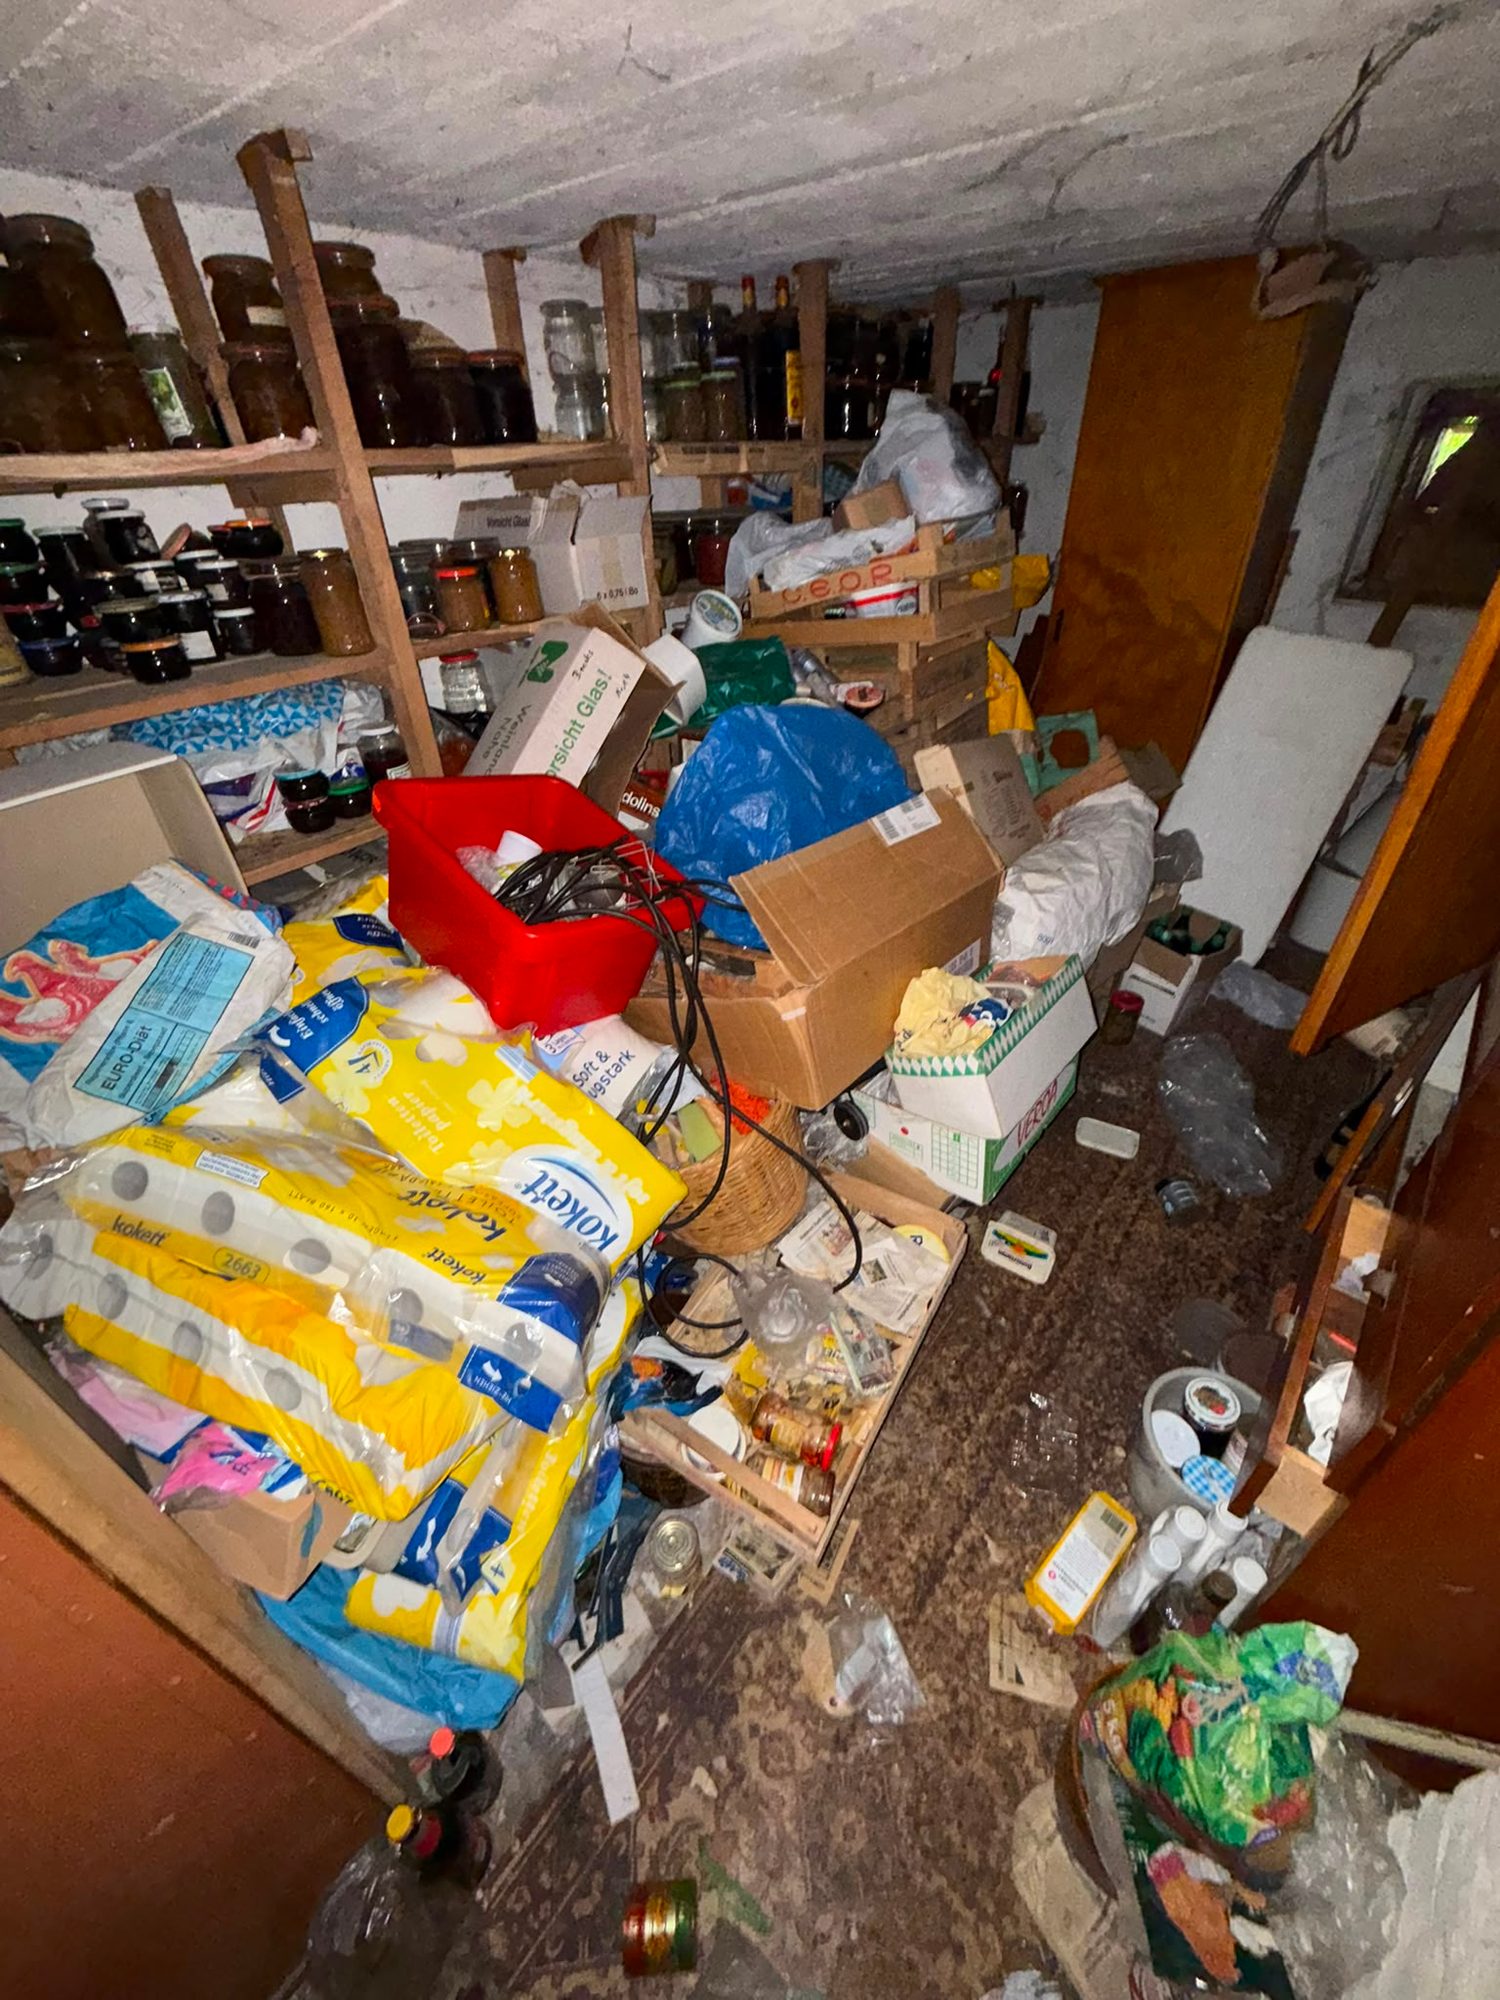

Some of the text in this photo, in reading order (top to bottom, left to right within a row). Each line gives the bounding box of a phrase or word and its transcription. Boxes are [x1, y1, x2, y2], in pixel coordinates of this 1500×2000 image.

[577, 668, 612, 718] Glas!
[482, 717, 512, 760] Nahe
[101, 1024, 153, 1091] EURO-Diät
[572, 1050, 611, 1088] Soft &
[112, 1215, 166, 1247] kokett
[521, 1169, 620, 1253] kokett
[223, 1252, 262, 1279] 2663
[429, 1246, 488, 1286] kokett
